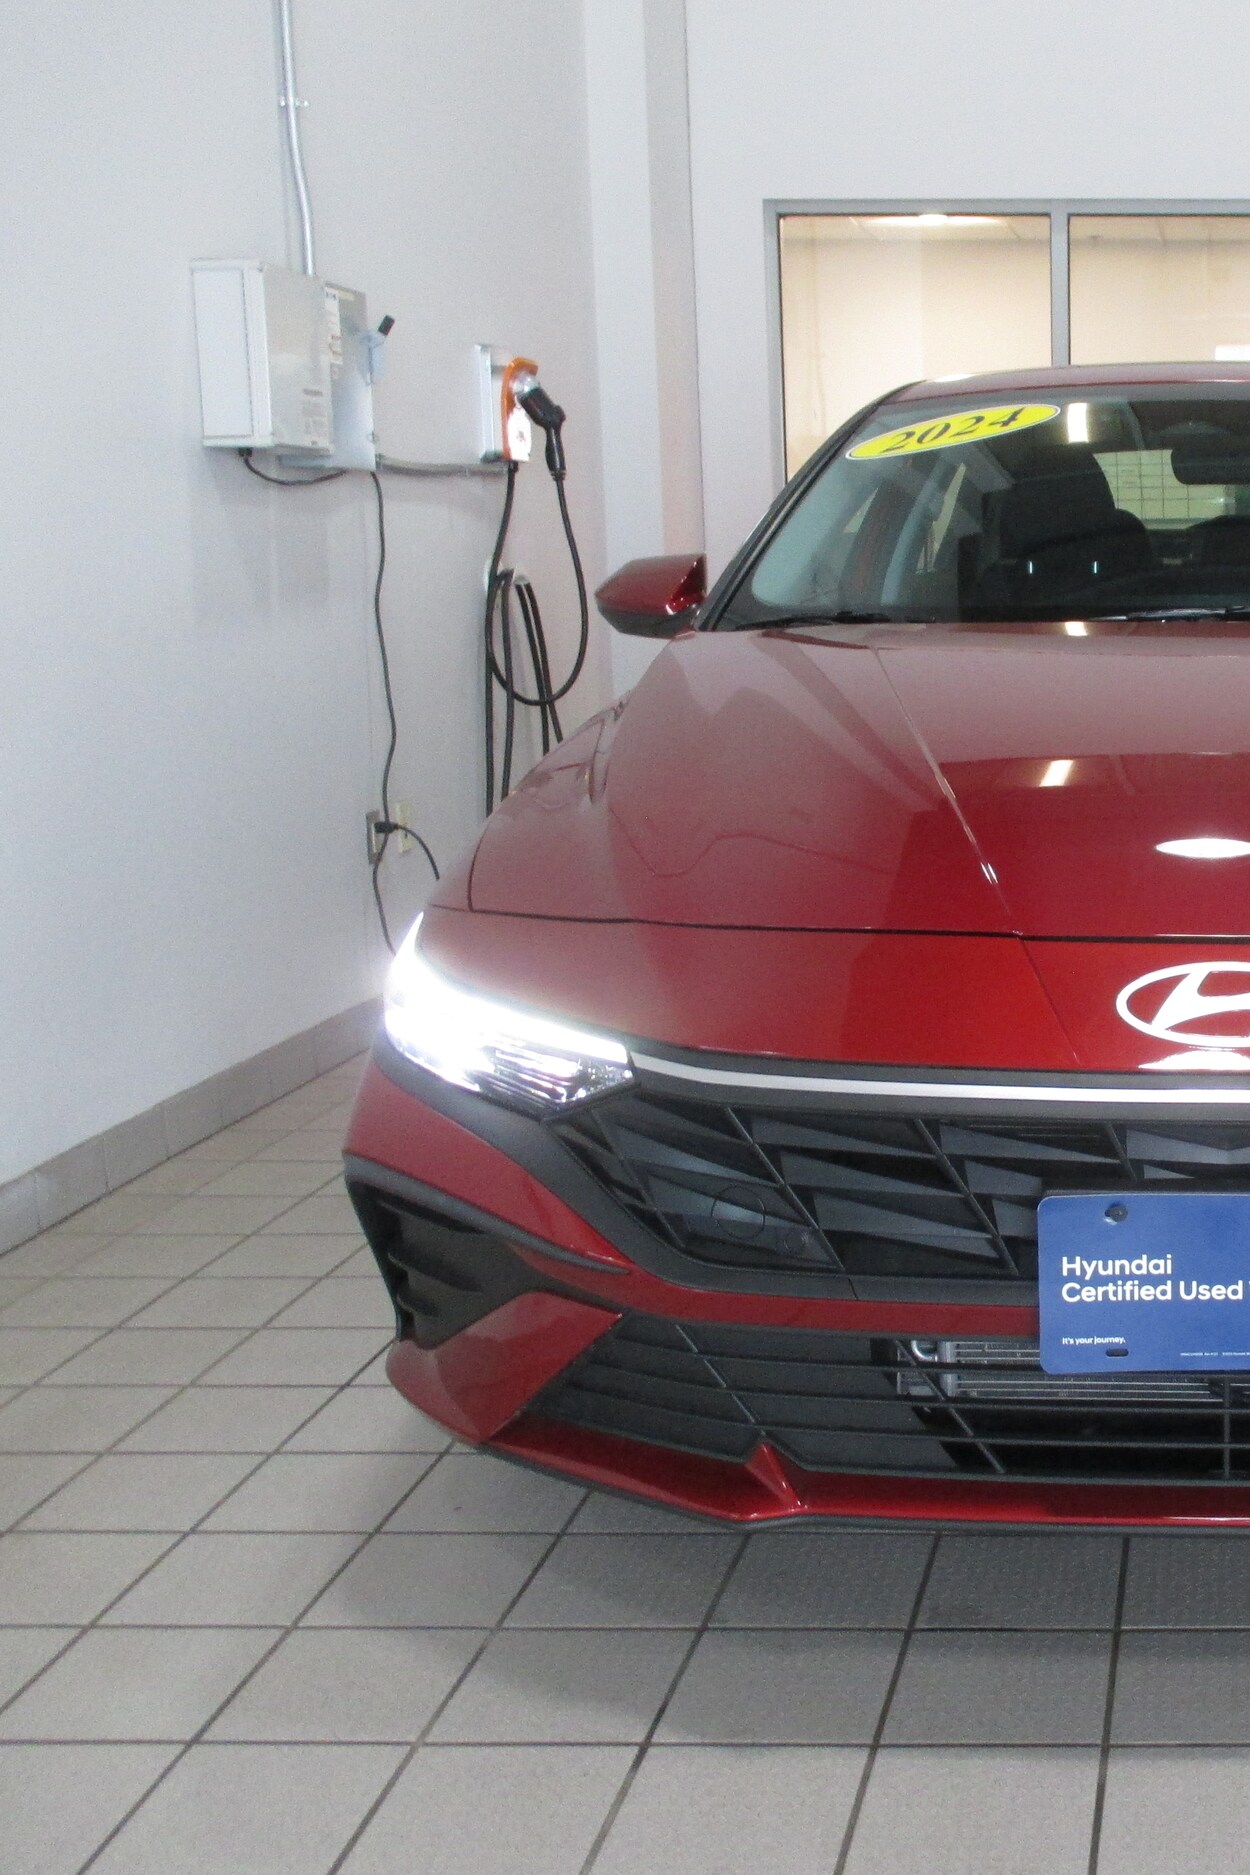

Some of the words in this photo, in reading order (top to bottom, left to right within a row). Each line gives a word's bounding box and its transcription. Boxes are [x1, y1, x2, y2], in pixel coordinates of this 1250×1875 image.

[880, 406, 1025, 454] 2024
[1062, 1254, 1172, 1281] Hyundai
[1061, 1280, 1172, 1303] Certified
[1179, 1280, 1243, 1300] Used
[1062, 1337, 1074, 1345] It's
[1075, 1337, 1093, 1345] your
[1093, 1336, 1126, 1345] journey.
